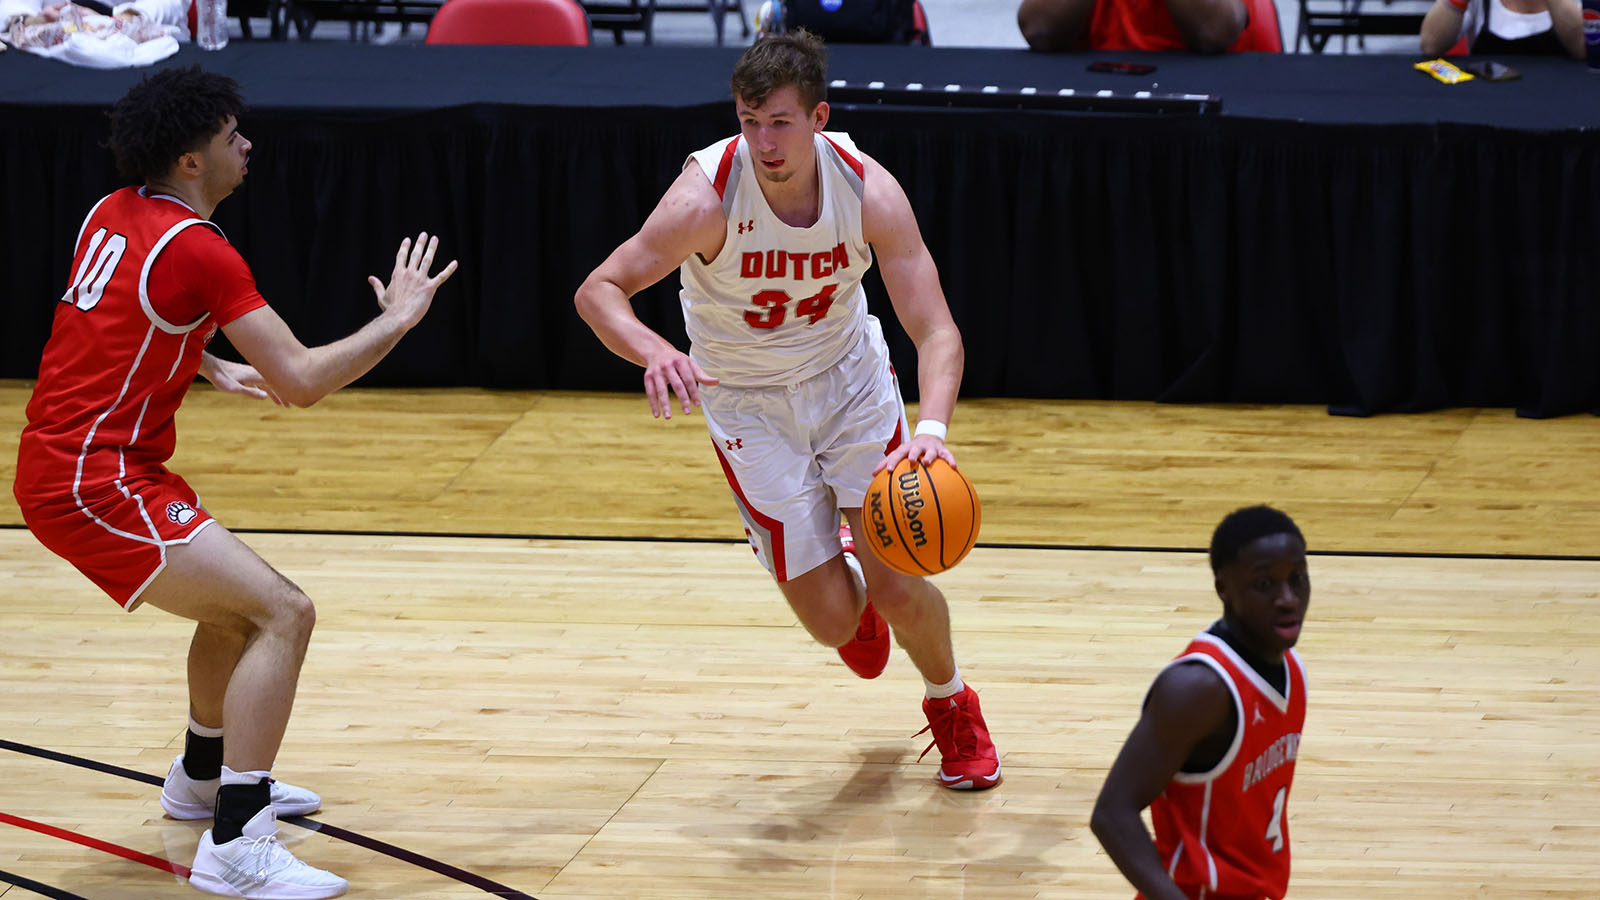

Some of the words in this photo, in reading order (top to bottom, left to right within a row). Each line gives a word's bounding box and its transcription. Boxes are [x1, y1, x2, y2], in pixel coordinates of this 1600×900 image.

[61, 226, 128, 313] 10
[740, 242, 850, 280] DUTCH
[743, 283, 840, 330] 34
[871, 491, 894, 548] NCAA
[898, 469, 927, 548] Wilson
[1265, 786, 1287, 852] 4
